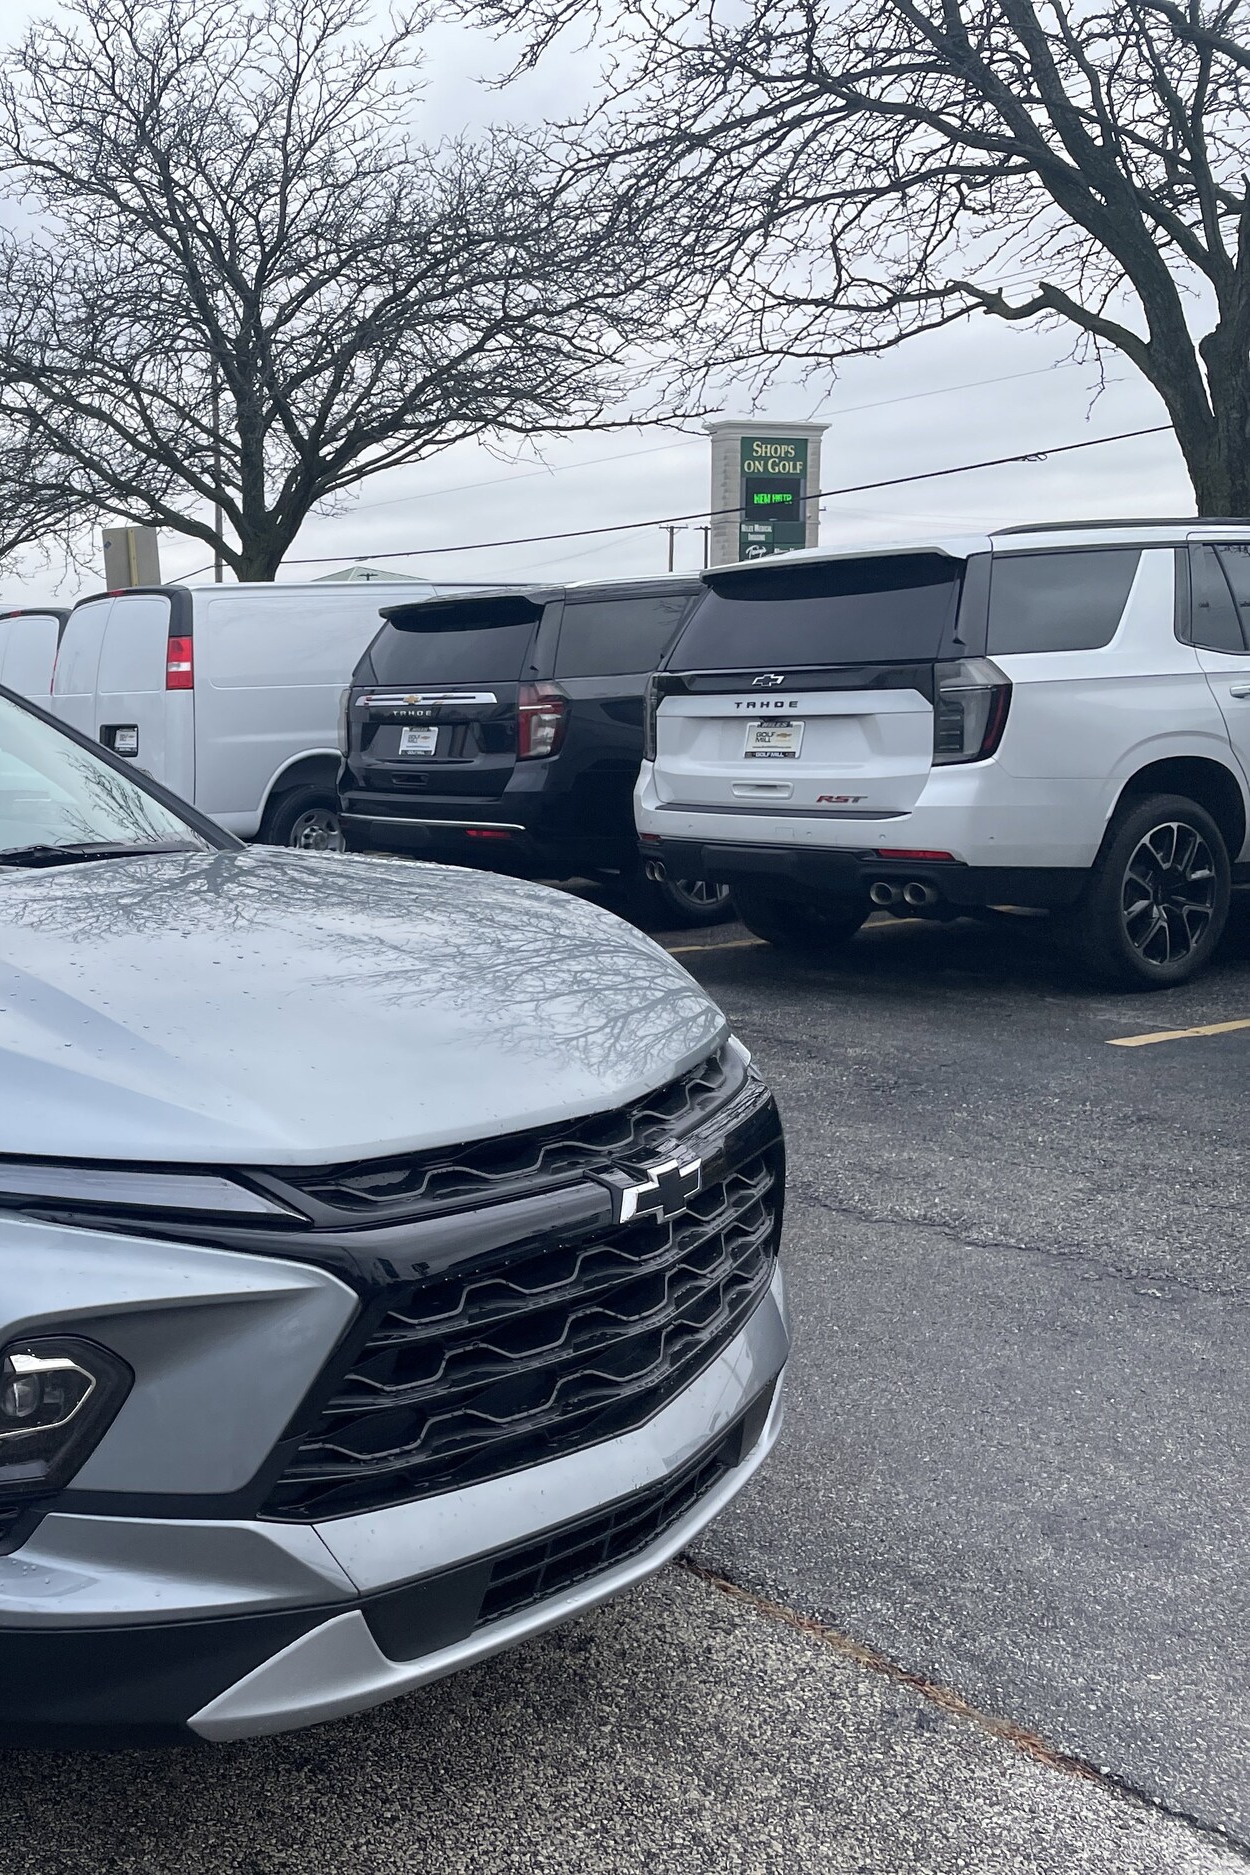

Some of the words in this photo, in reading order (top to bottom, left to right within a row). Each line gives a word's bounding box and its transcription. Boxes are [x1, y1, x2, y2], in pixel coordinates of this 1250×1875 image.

[752, 441, 796, 457] SHOPS
[743, 460, 764, 473] ON
[767, 458, 803, 473] GOLF
[733, 700, 799, 709] TAHOE
[816, 795, 869, 803] RST
